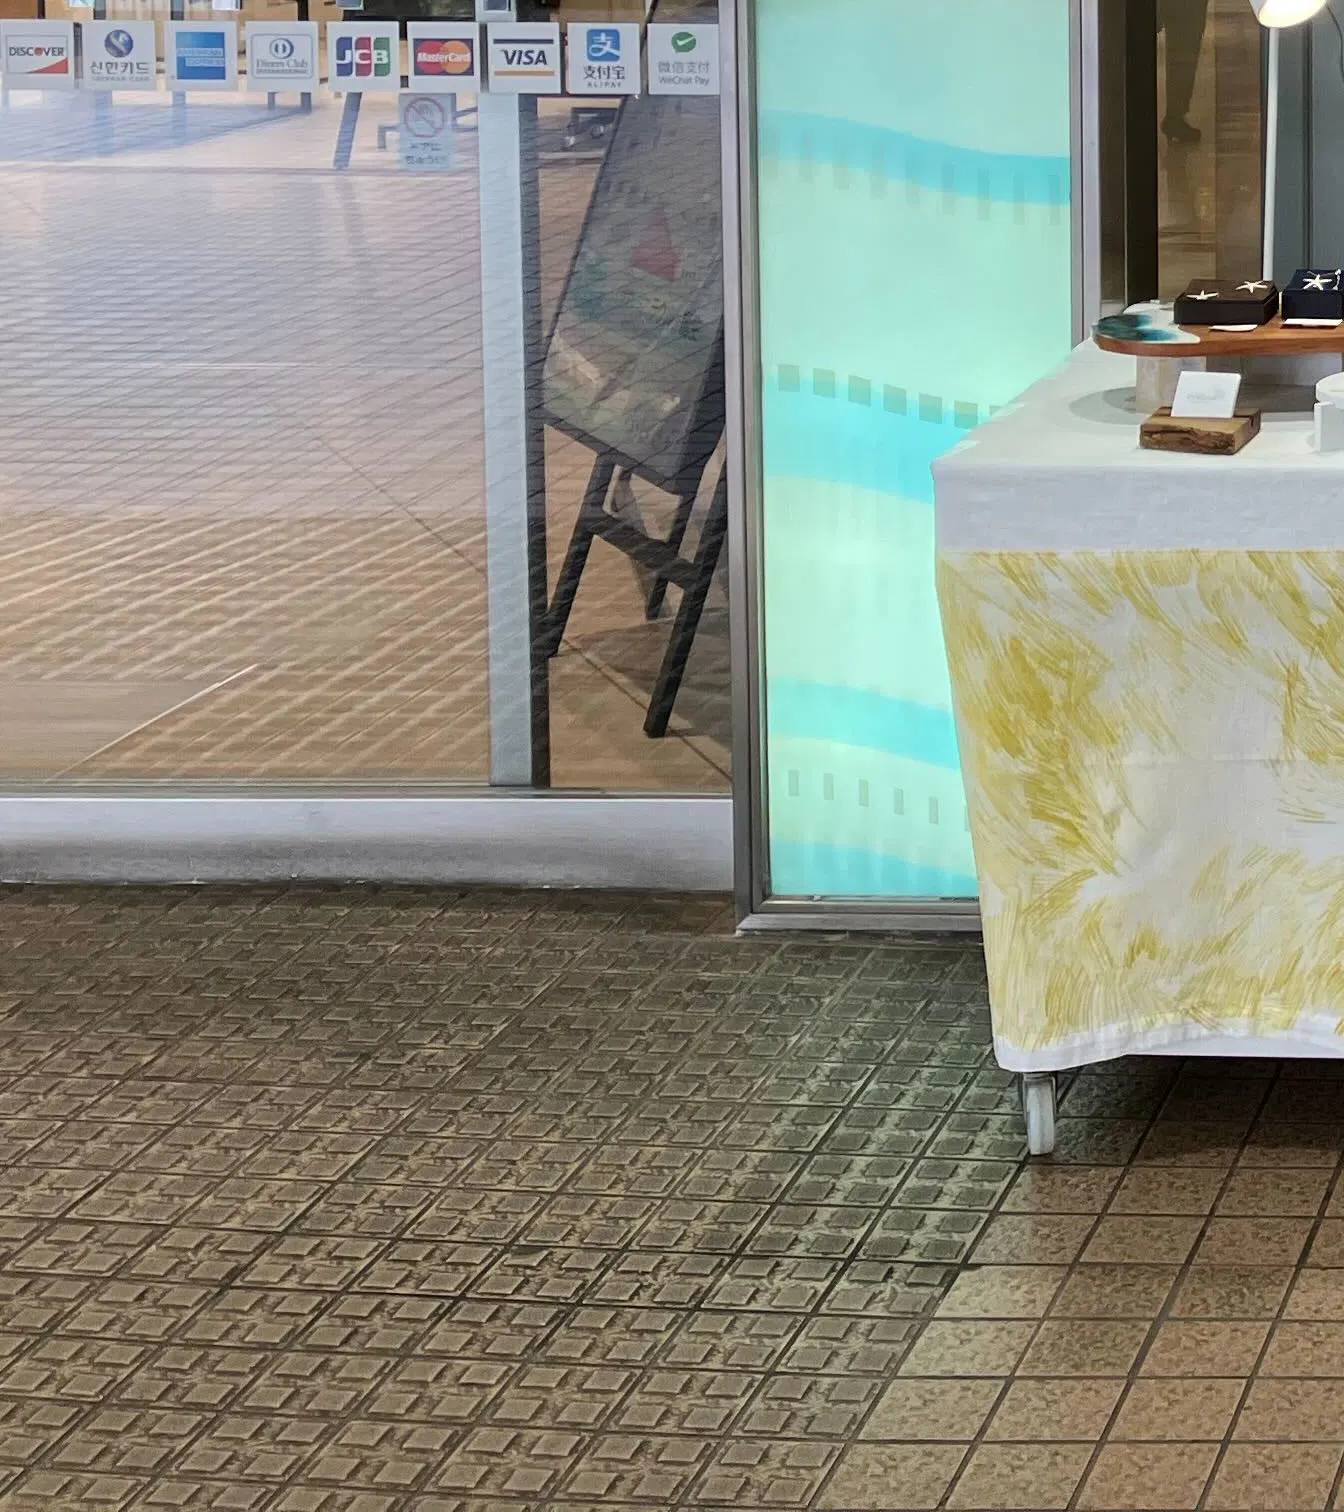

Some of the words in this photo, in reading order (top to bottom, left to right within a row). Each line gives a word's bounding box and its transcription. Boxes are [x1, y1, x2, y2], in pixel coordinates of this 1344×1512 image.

[8, 46, 65, 57] DISCOVER
[335, 48, 389, 65] JCB
[416, 50, 472, 64] MasterCard
[501, 48, 548, 66] VISA
[583, 65, 626, 81] 支付宝
